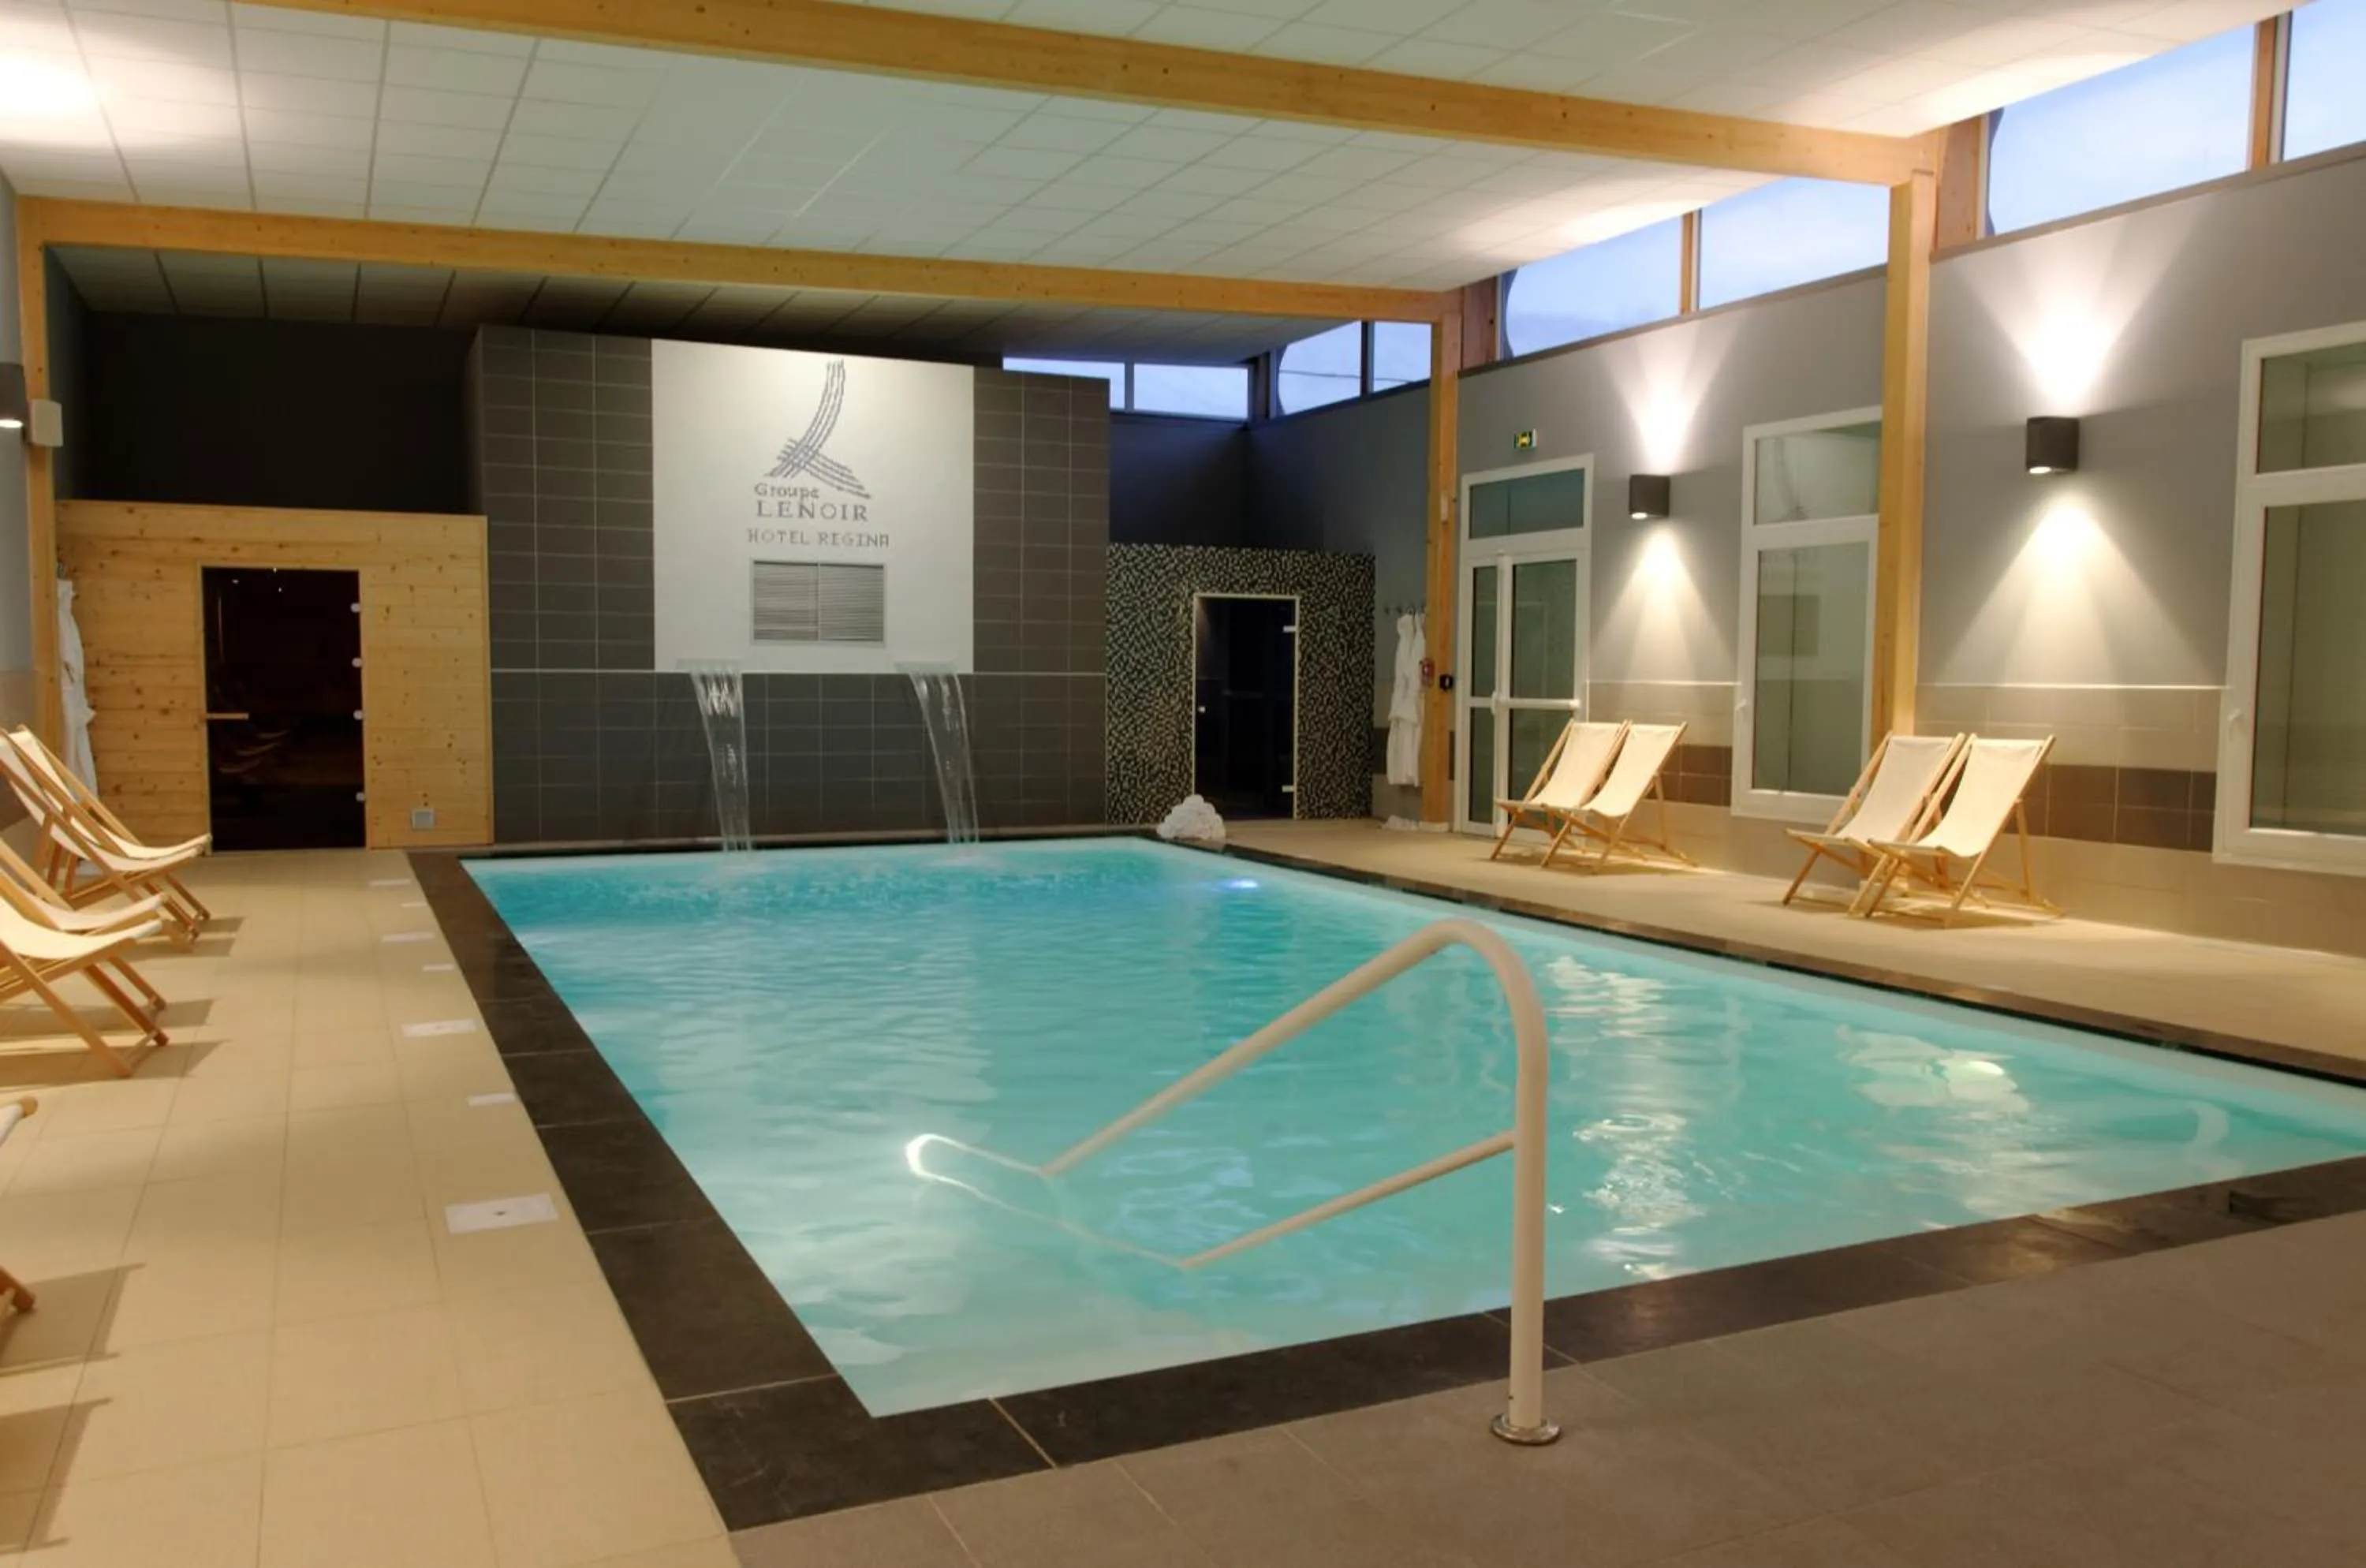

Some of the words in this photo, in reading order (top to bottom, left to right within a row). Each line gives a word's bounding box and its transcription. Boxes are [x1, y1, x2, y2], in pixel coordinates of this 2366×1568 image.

[754, 483, 820, 500] Groupe
[756, 500, 868, 521] LENOIR
[747, 528, 811, 546] HOTEL
[817, 531, 889, 548] REGINA
